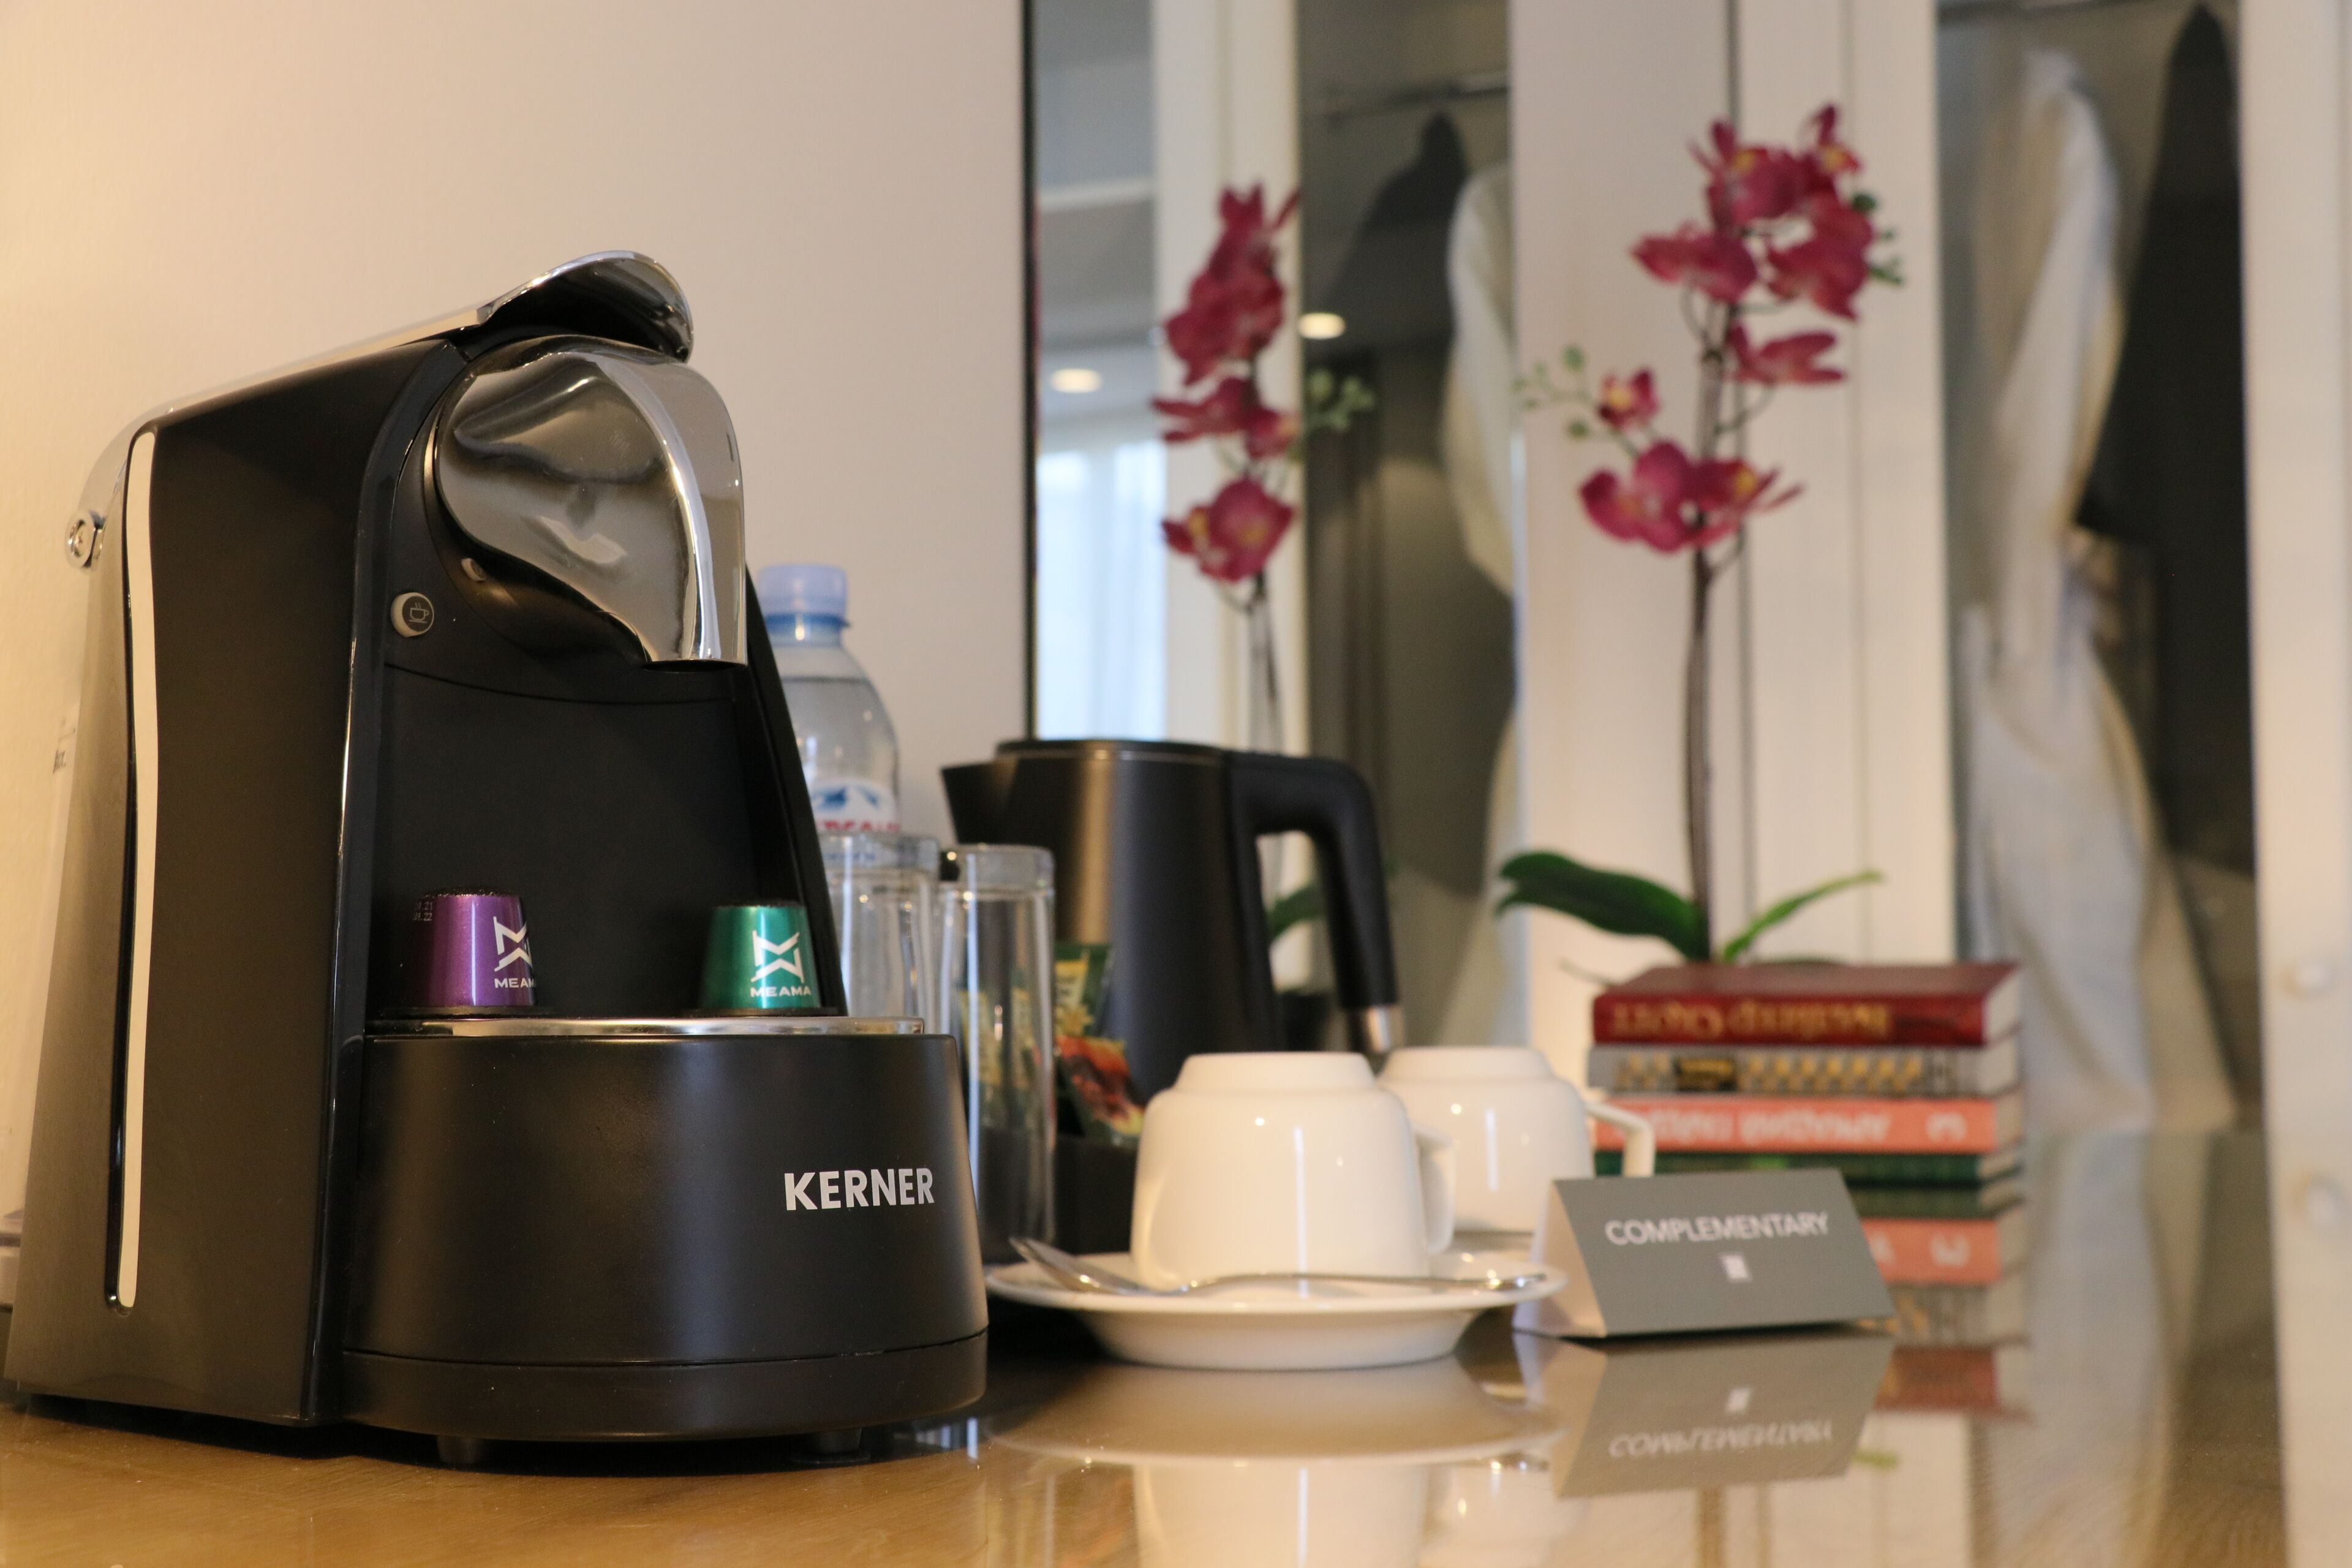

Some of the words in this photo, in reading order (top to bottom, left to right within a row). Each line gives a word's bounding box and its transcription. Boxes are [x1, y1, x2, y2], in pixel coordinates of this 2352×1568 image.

[494, 977, 535, 989] MEAM
[750, 985, 812, 998] MEAMA
[784, 1167, 935, 1212] KERNER
[1605, 1211, 1829, 1246] COMPLEMENTARY
